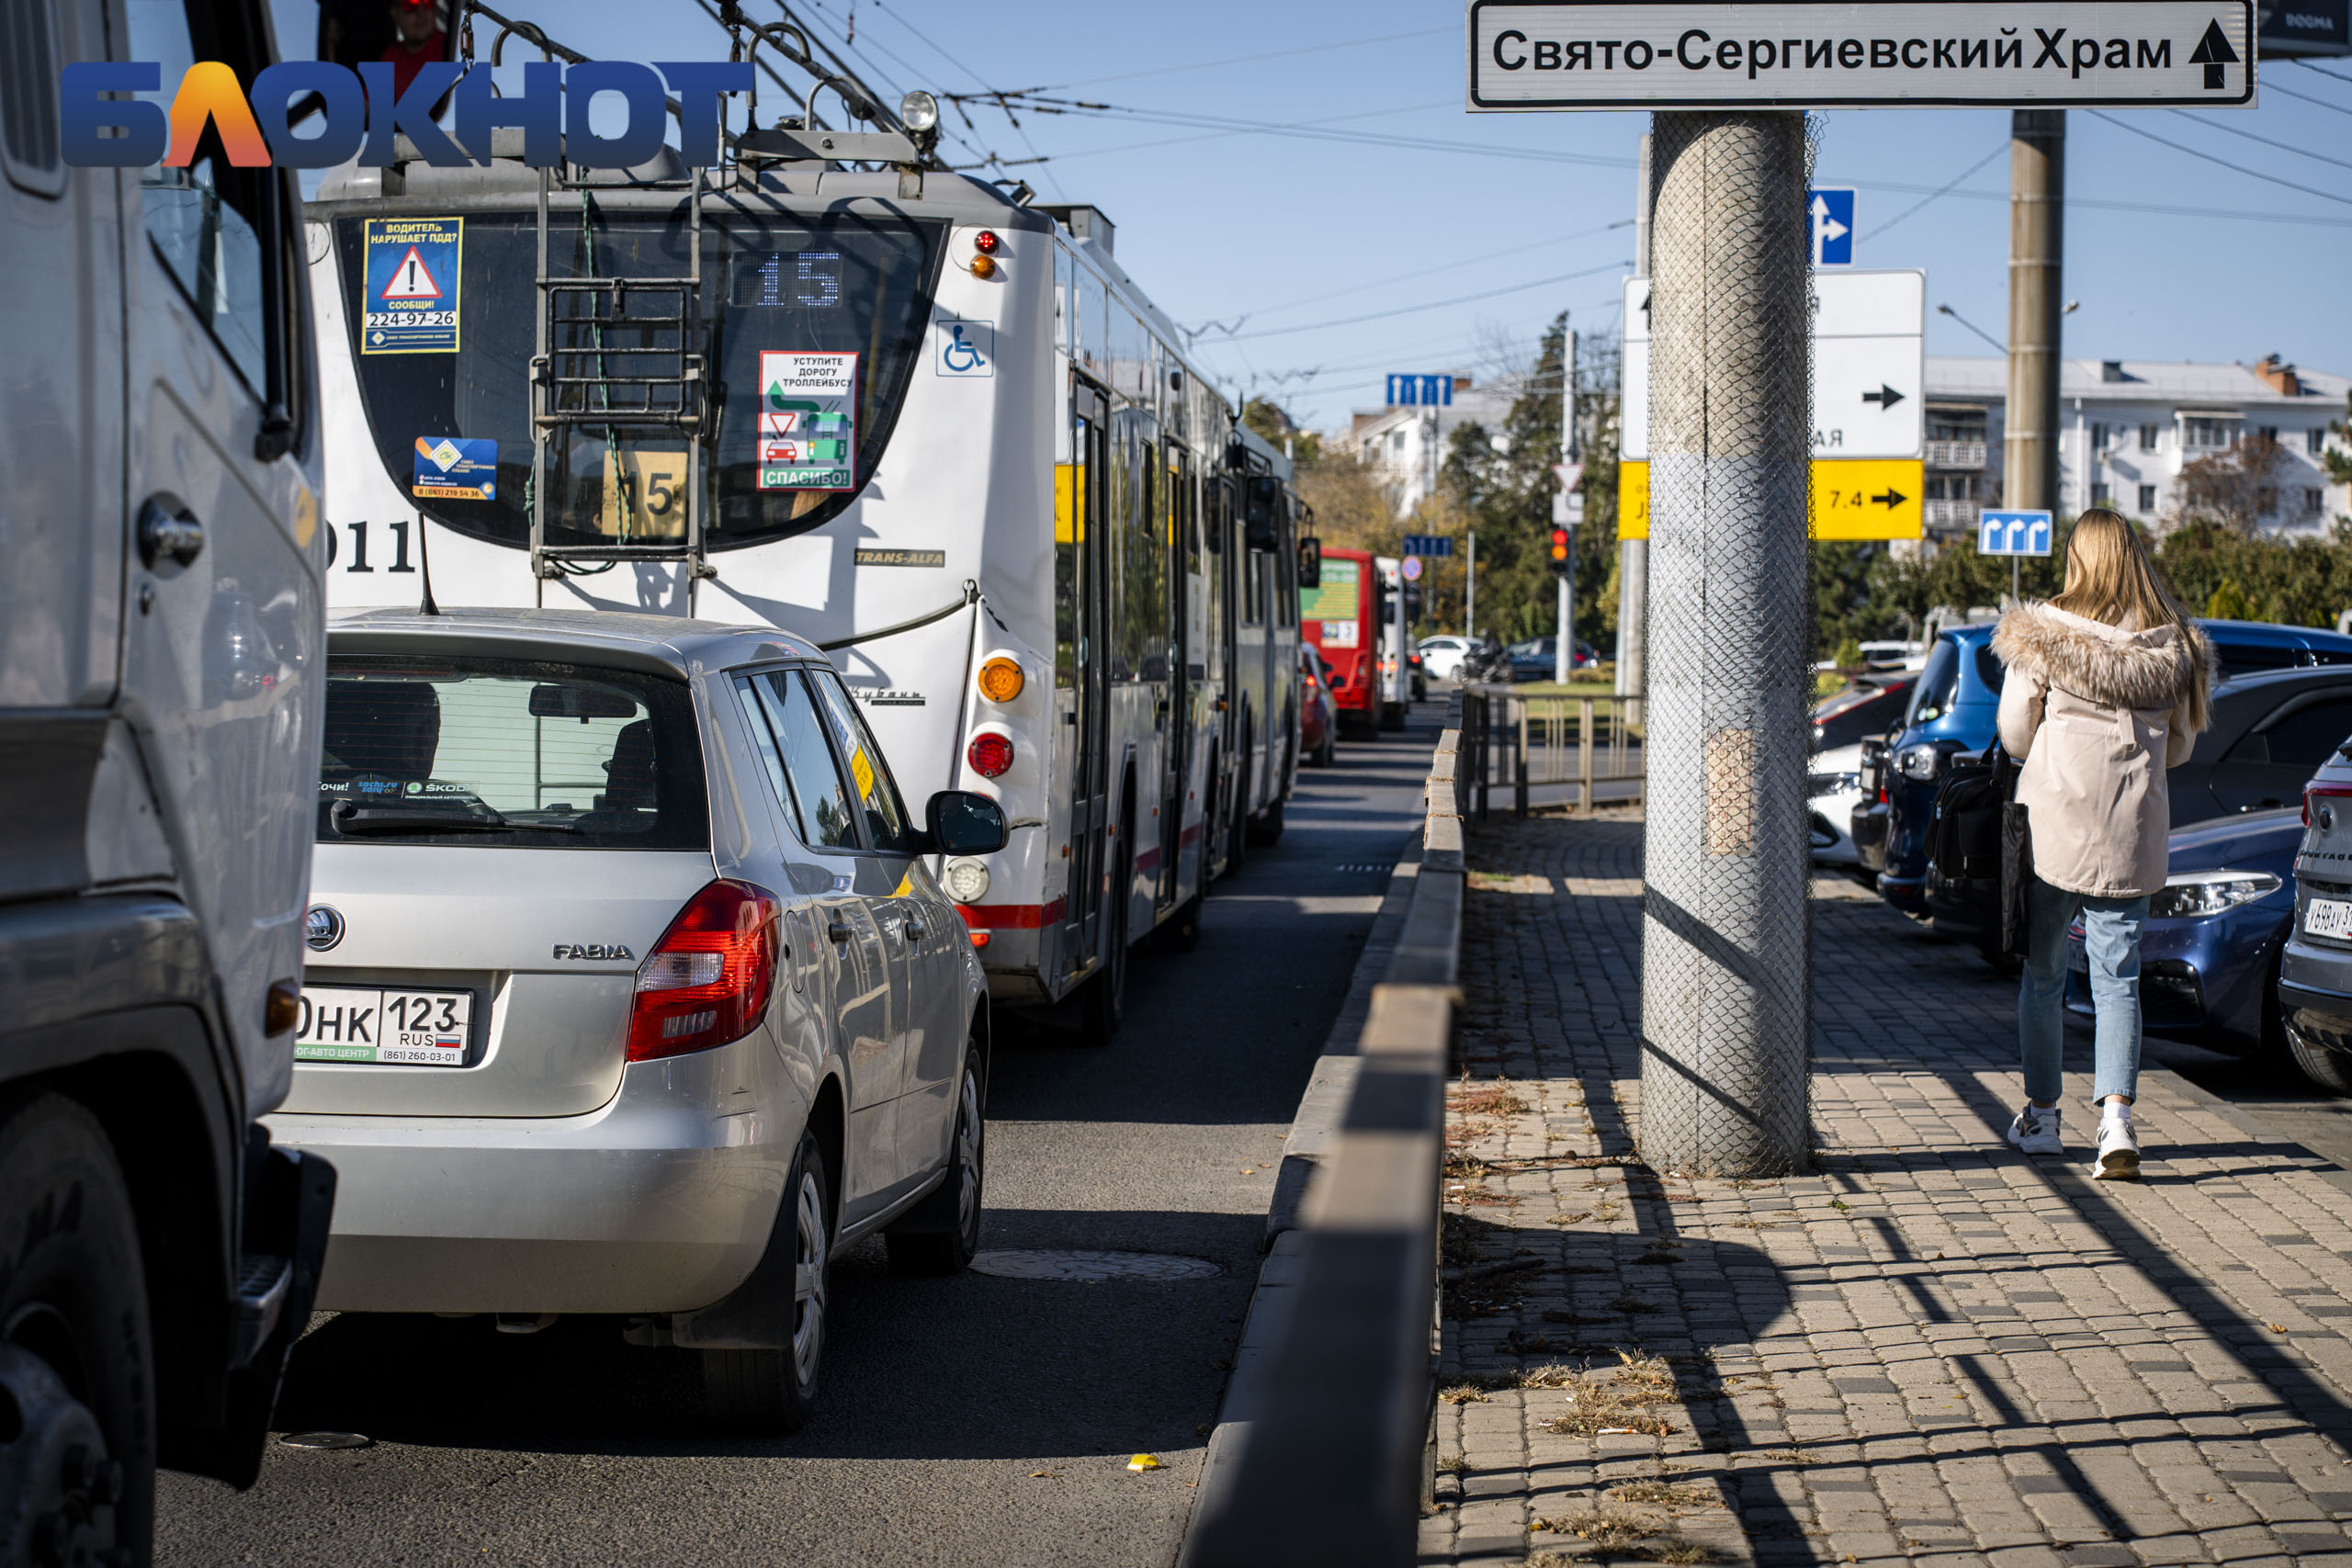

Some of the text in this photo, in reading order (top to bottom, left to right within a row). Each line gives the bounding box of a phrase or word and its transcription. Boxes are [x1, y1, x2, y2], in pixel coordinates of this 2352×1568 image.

[1493, 27, 2172, 80] Свято-Сергиевский Храм
[386, 223, 442, 234] ВОДИТЕЛЬ
[370, 232, 458, 244] НАРУШАЕТ ПДД?
[757, 253, 839, 306] 15
[389, 300, 435, 310] СООБЩИ!
[369, 312, 454, 326] 224-97-26
[794, 357, 843, 366] УСТУПИТЕ
[798, 368, 837, 378] ДОРОГУ
[783, 378, 854, 388] ТРОЛЛЕЙБУСУ
[766, 470, 847, 484] СПАСИБО!
[1829, 489, 1861, 509] 7.4
[855, 551, 944, 564] TRANS-ALFA
[552, 944, 633, 960] FABIA
[388, 996, 458, 1032] 123
[400, 1033, 434, 1046] RUS
[337, 1049, 369, 1058] ЦЕНТР
[384, 1049, 456, 1061] (861) 260-03-01
